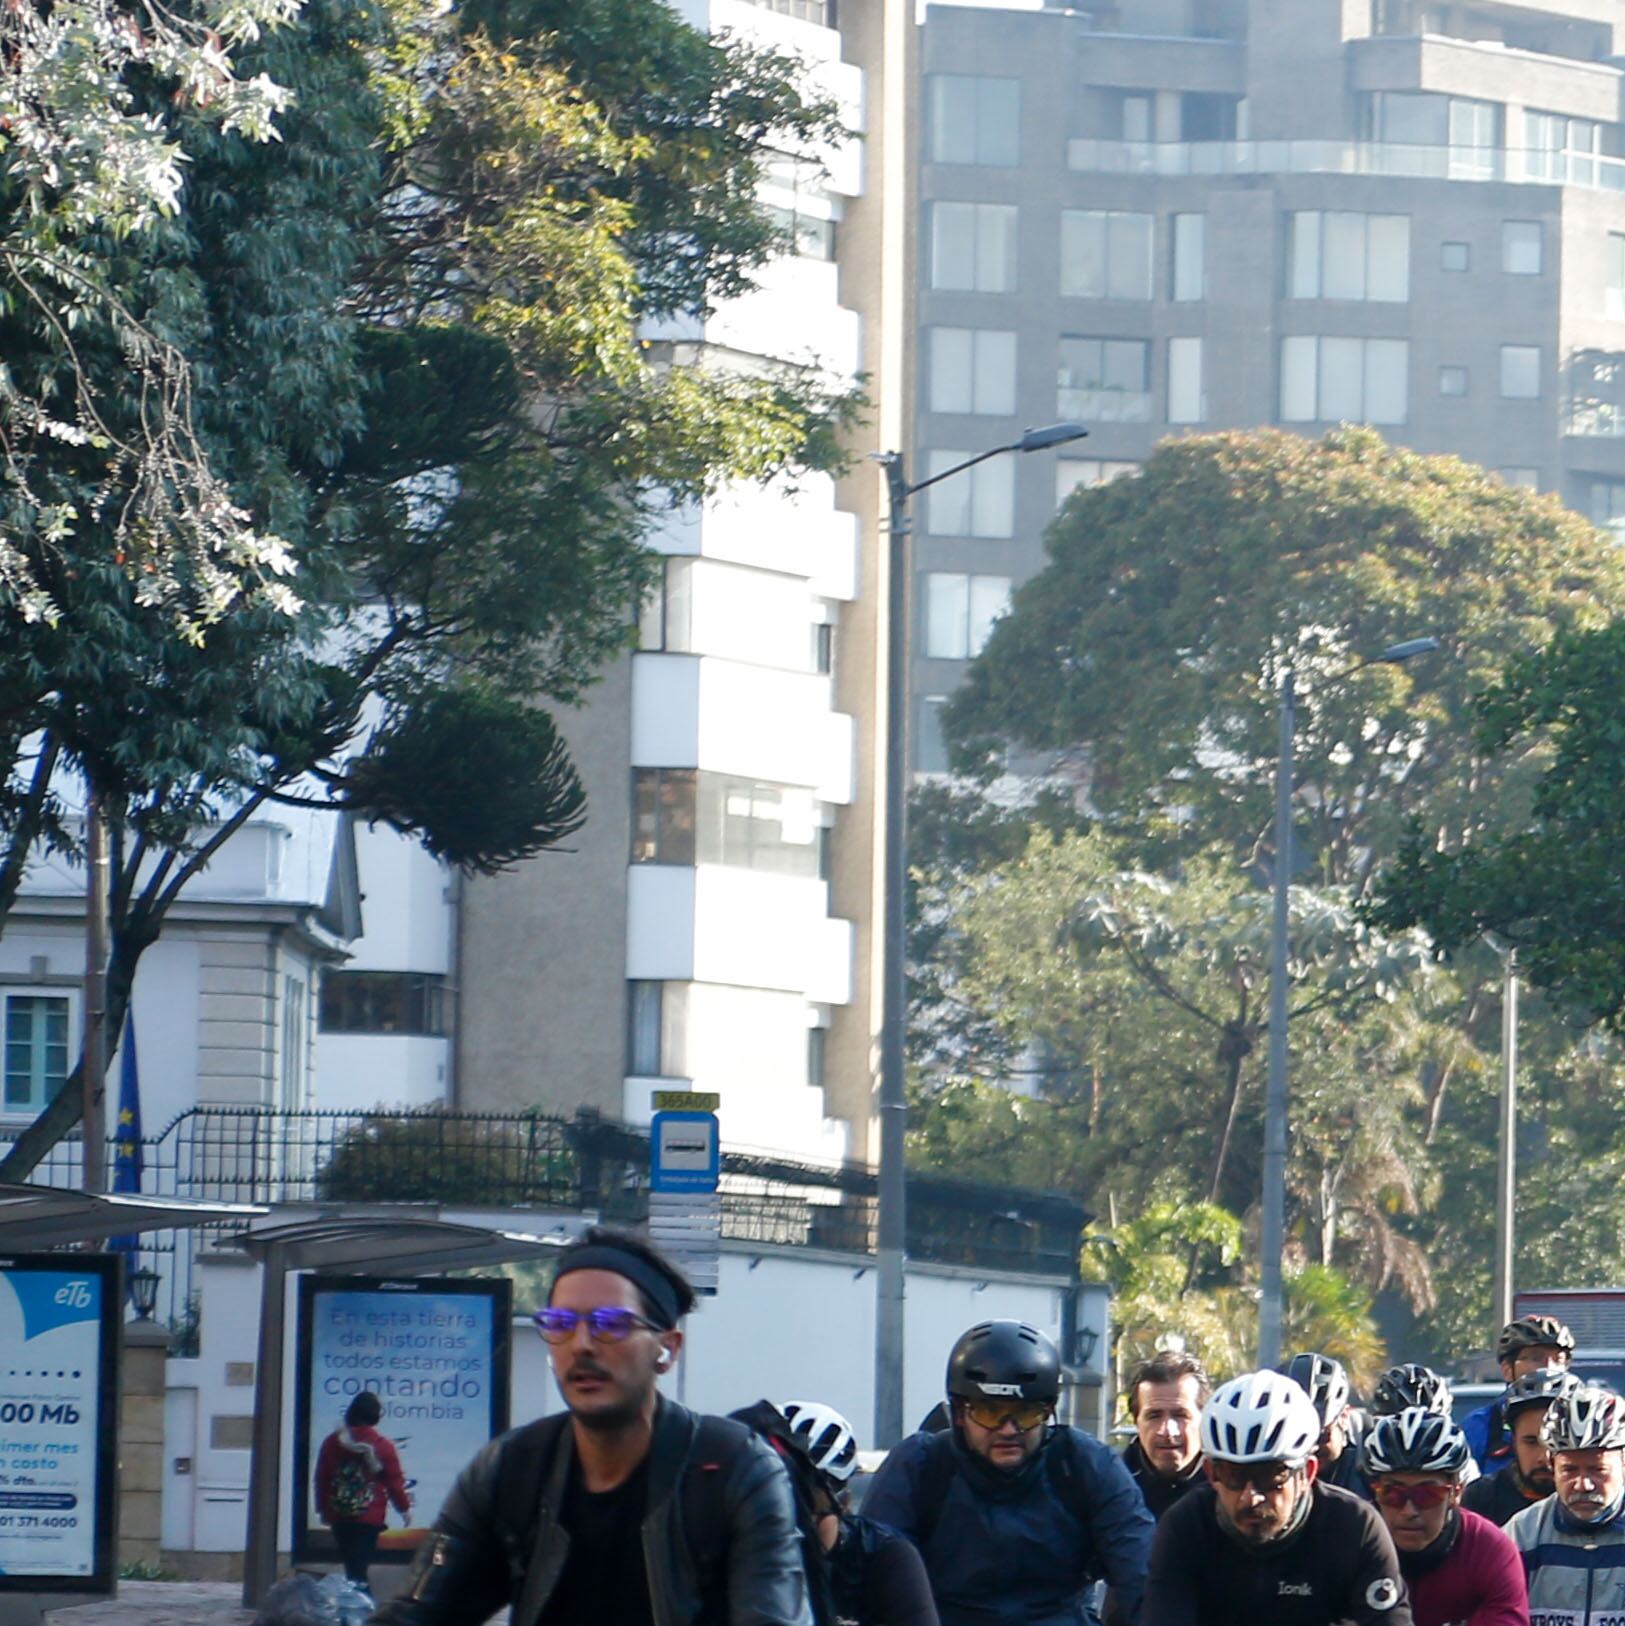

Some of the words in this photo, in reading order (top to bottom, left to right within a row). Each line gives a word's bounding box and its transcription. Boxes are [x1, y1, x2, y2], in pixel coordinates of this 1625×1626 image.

[331, 1309, 358, 1326] En
[366, 1311, 410, 1326] esta
[419, 1311, 476, 1328] tierra
[340, 1331, 367, 1347] de
[374, 1332, 466, 1348] historias
[324, 1352, 383, 1369] todos
[390, 1354, 481, 1371] estamos
[324, 1374, 481, 1398] contando
[39, 1404, 80, 1425] Mb
[11, 1458, 57, 1469] costo
[18, 1516, 39, 1527] 371
[42, 1517, 77, 1528] 4000
